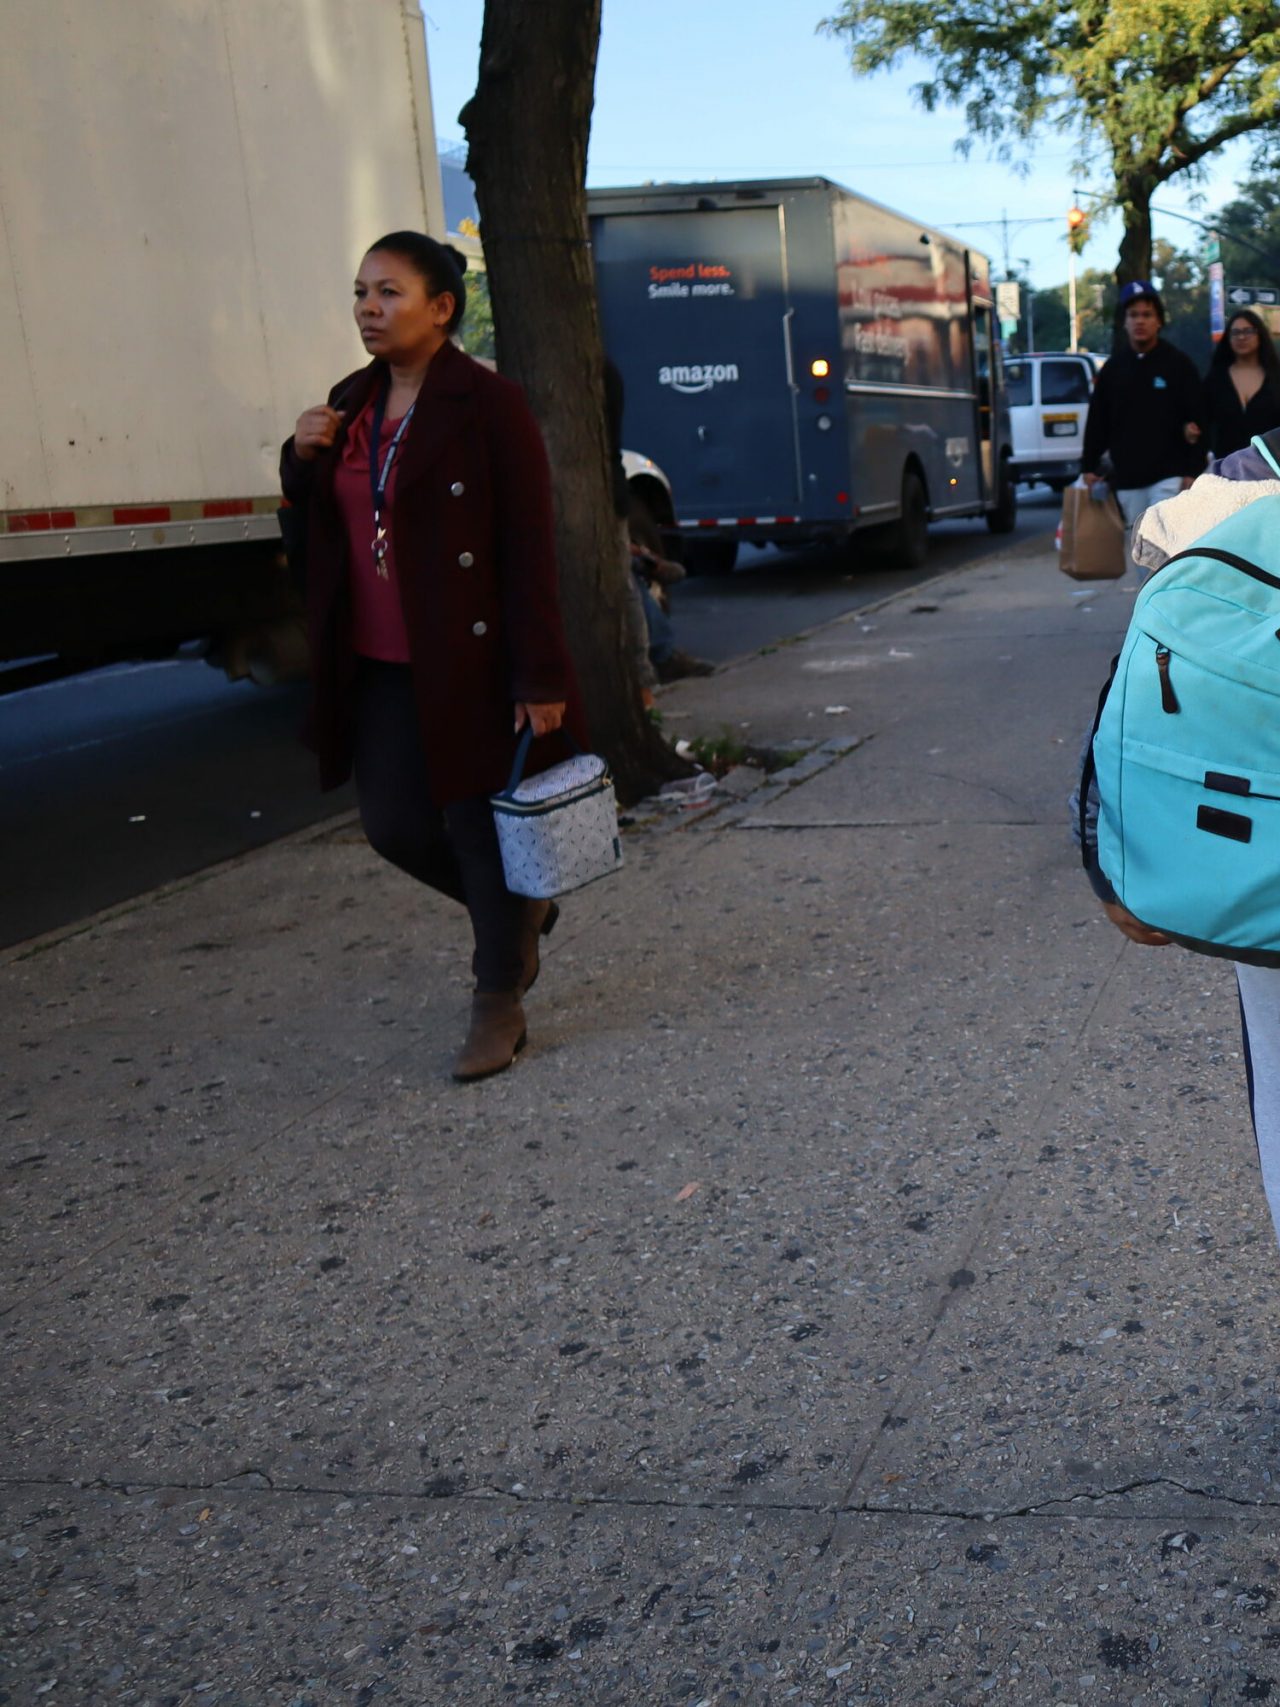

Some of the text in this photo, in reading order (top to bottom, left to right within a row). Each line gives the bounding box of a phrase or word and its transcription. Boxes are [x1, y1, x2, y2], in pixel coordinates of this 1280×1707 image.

[650, 263, 732, 282] Spend less.
[648, 282, 735, 299] Smile more.
[658, 364, 739, 384] amazon
